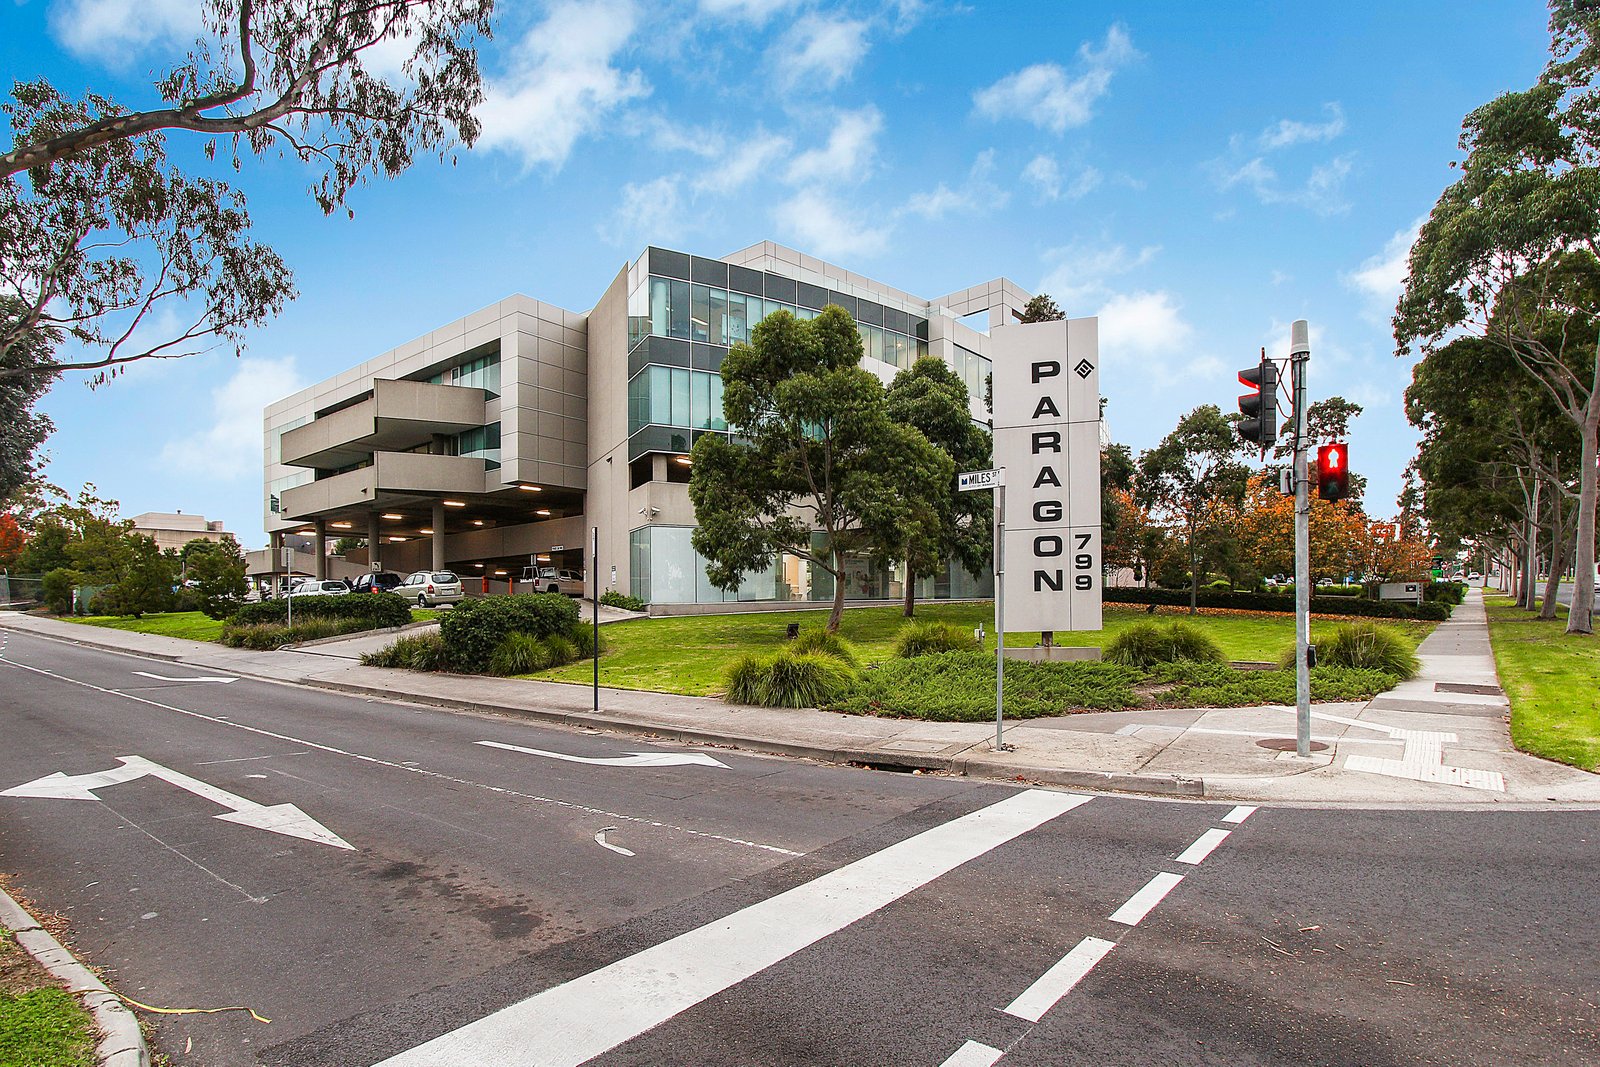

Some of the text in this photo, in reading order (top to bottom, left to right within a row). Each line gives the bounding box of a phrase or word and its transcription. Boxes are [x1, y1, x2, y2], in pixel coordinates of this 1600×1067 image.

[969, 472, 991, 485] MILES
[1031, 360, 1063, 592] PARAGON
[1074, 533, 1093, 591] 799
